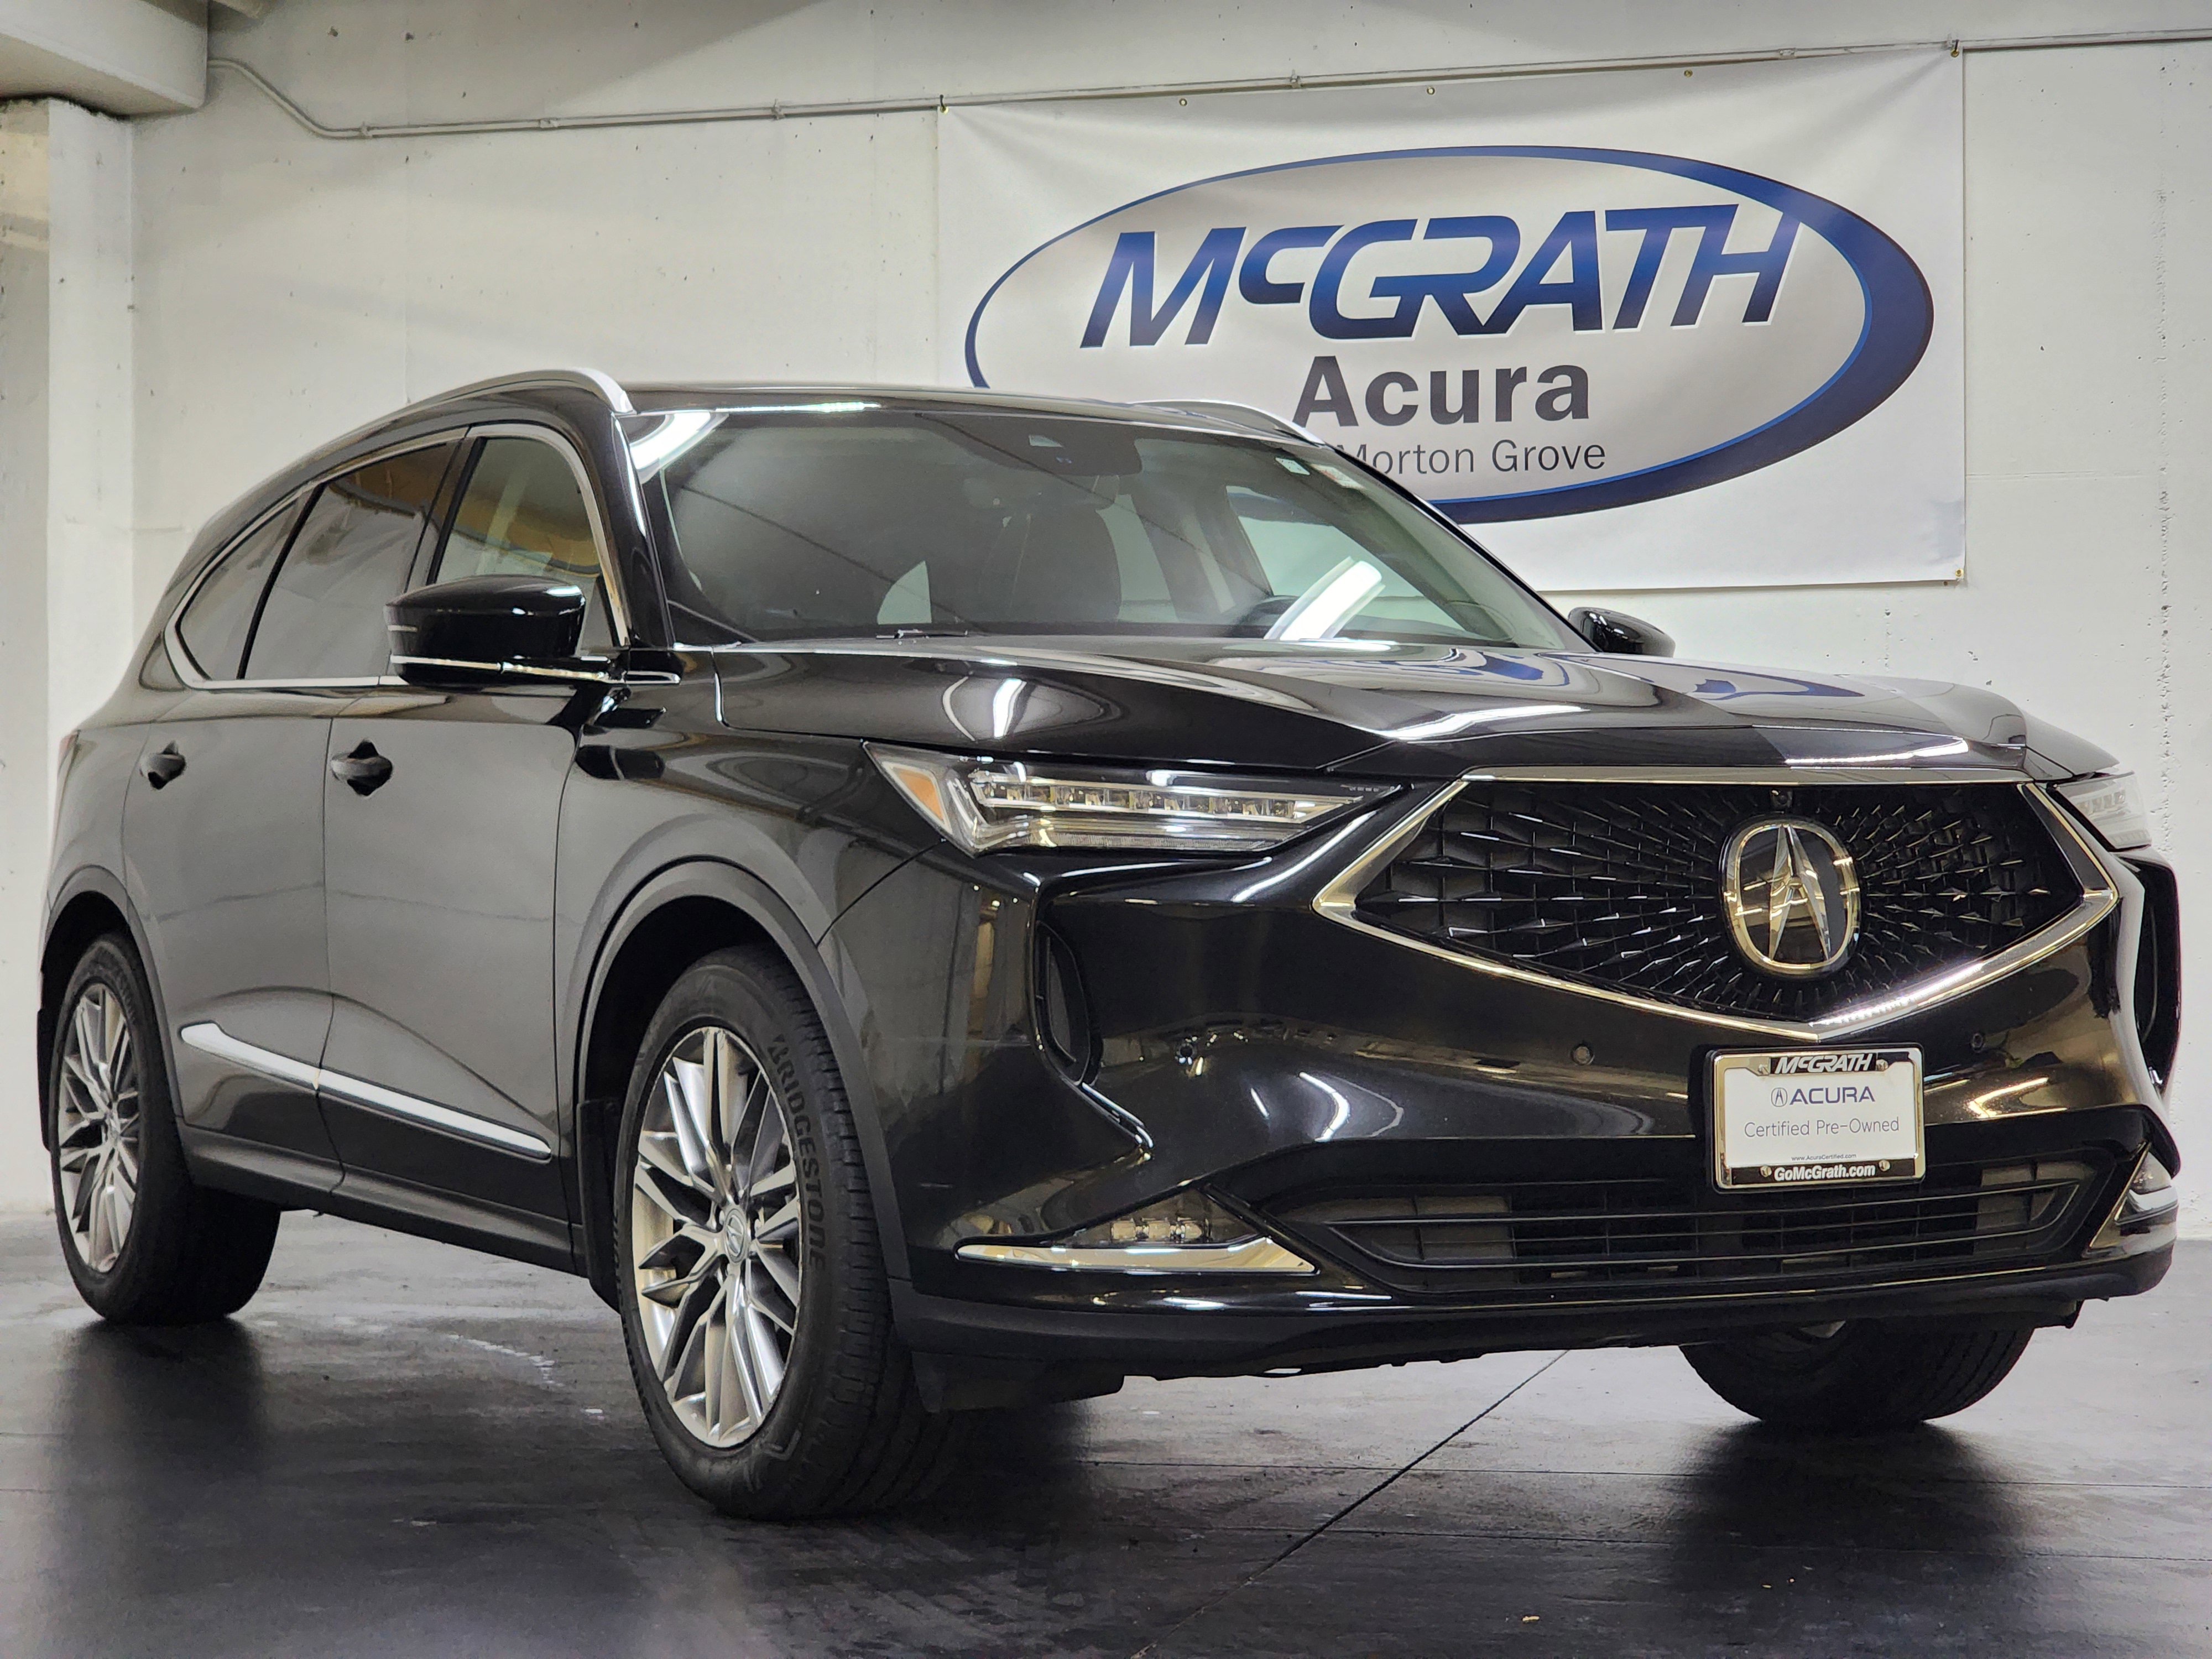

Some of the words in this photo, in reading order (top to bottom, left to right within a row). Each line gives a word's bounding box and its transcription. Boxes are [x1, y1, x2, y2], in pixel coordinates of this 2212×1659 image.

[1294, 355, 1591, 427] Acura
[1491, 439, 1606, 472] Grove
[1790, 1086, 1875, 1105] ACURA
[1744, 1120, 1810, 1138] Certified
[1817, 1117, 1900, 1135] Pre-Owned
[767, 1034, 826, 1272] BRIDGESTONE
[1774, 1164, 1876, 1181] GoMcGrath.com
